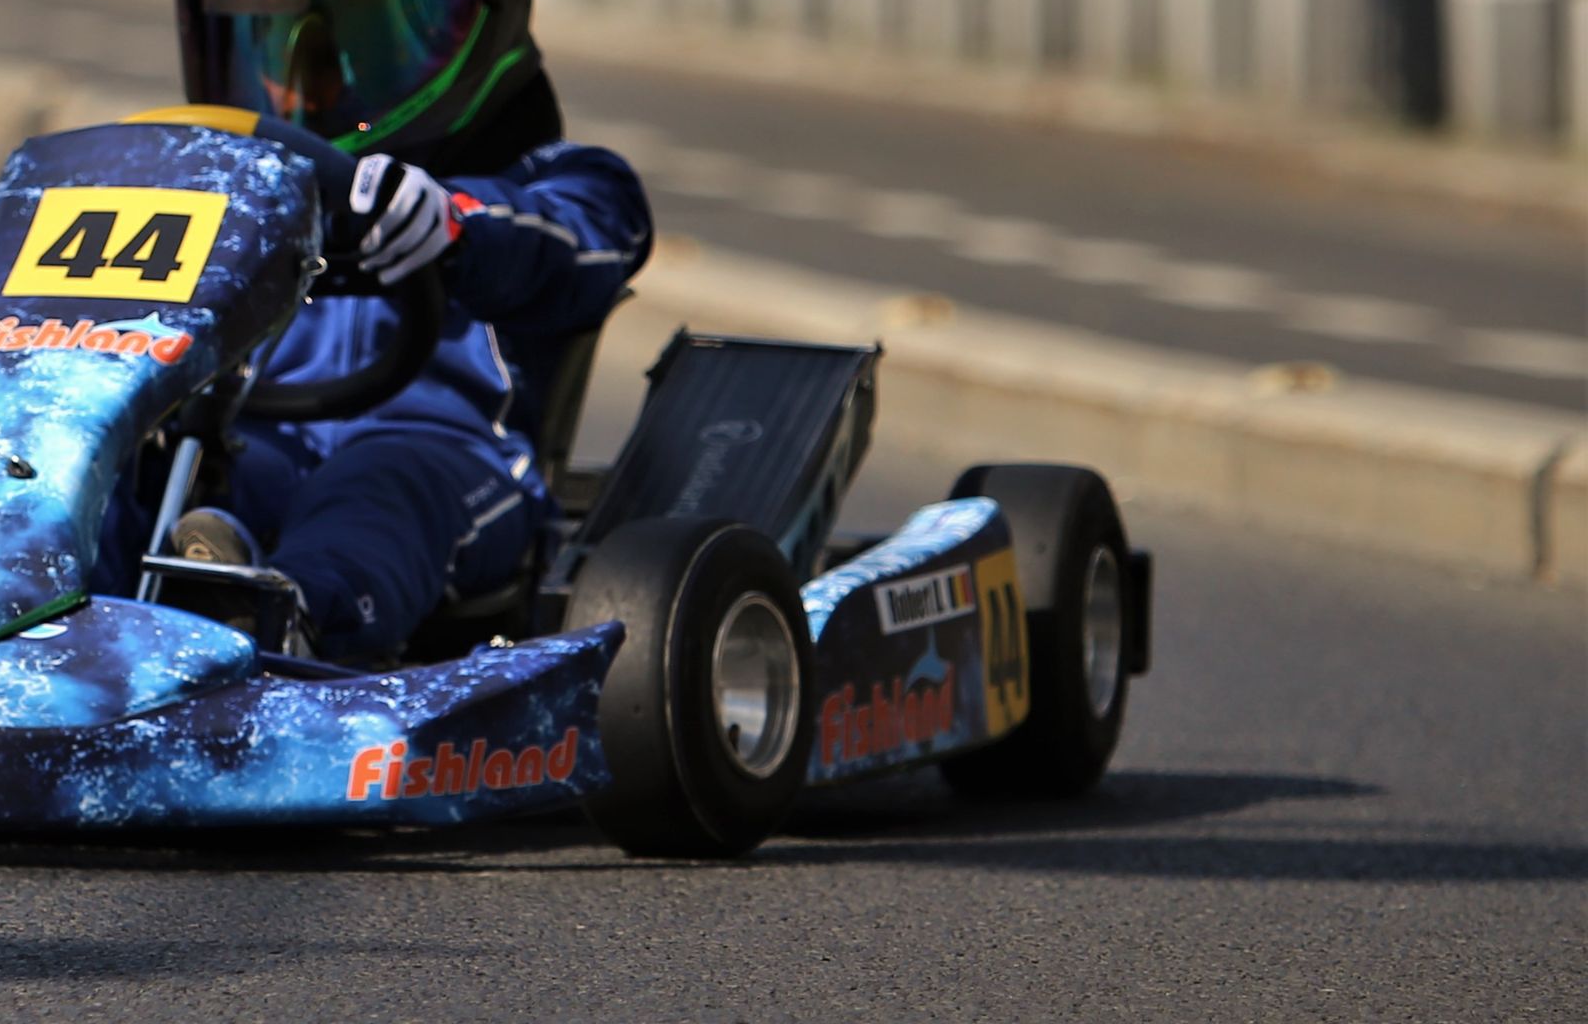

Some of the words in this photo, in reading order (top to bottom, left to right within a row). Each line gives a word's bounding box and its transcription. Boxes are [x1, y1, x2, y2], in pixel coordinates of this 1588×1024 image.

[36, 211, 192, 282] 44
[988, 582, 1024, 705] 44
[821, 660, 955, 767] Fishland
[346, 726, 579, 801] Fishland
